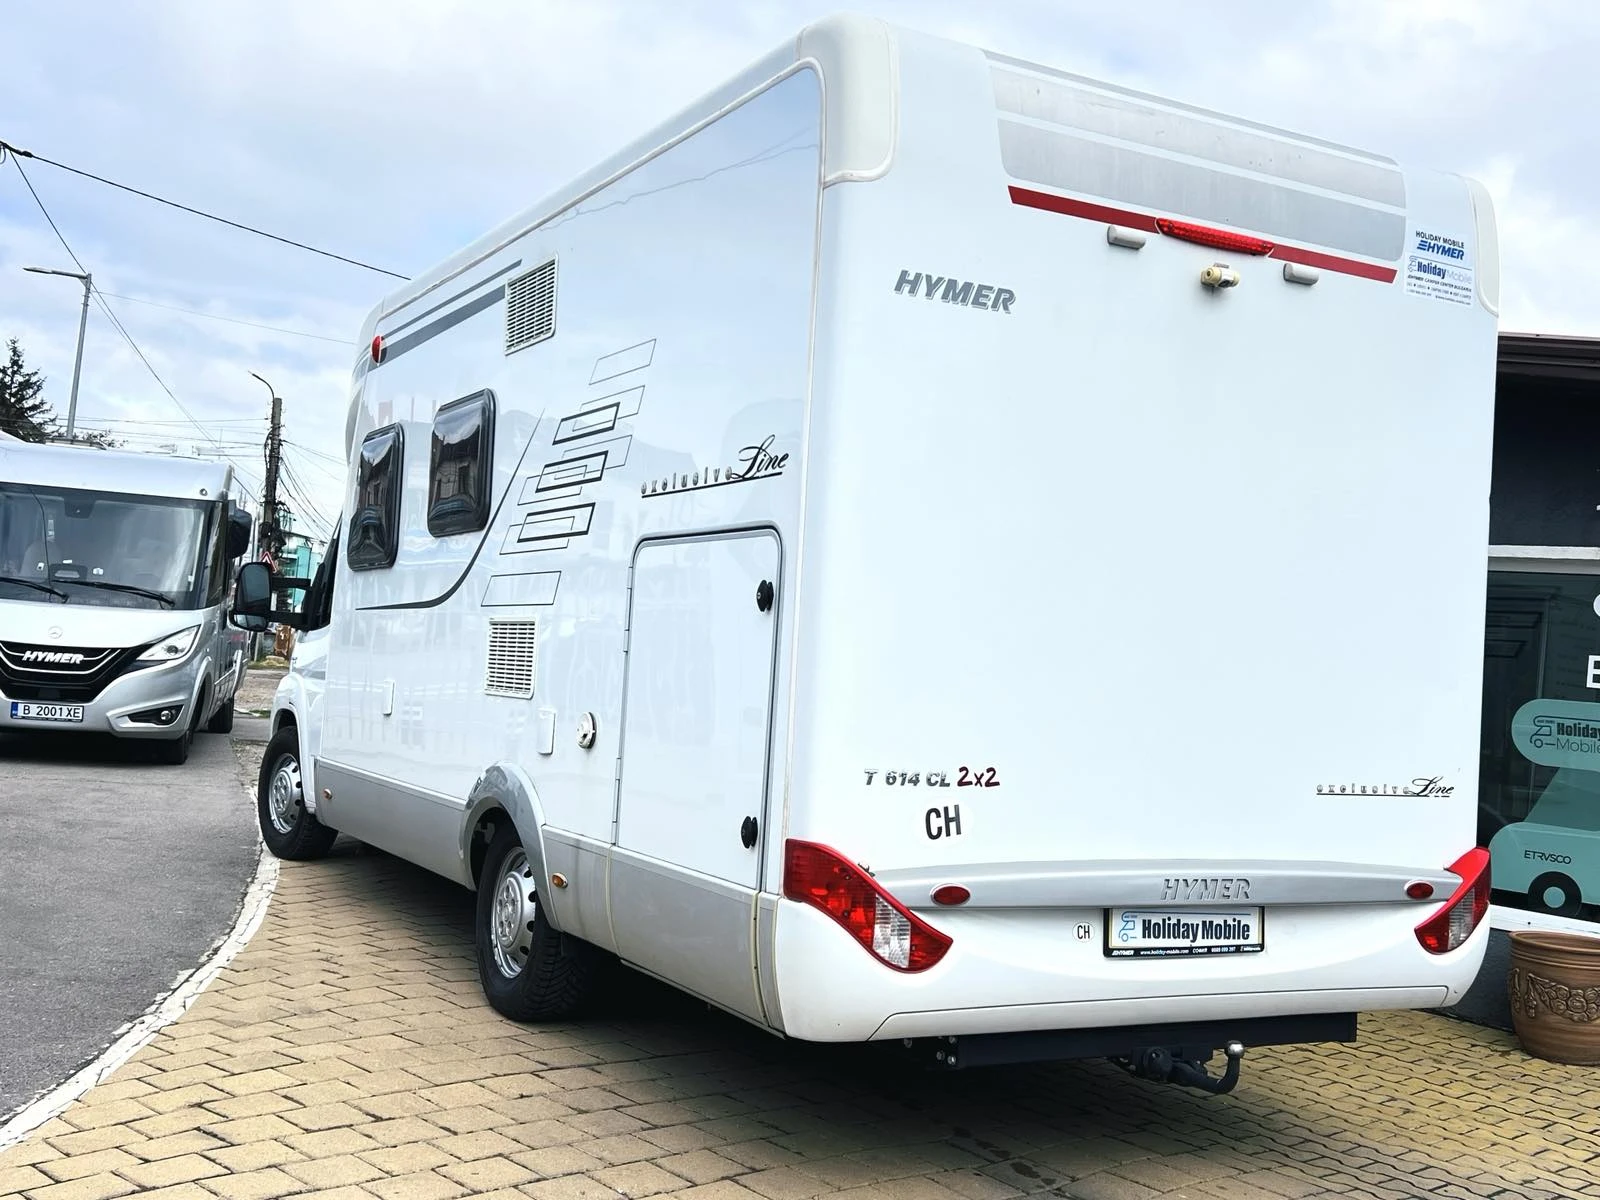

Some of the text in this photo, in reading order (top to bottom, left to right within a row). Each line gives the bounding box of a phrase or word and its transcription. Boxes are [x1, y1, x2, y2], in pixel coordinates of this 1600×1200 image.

[1416, 230, 1464, 249] HOLIDAY MOBILE
[1424, 241, 1464, 260] HYMER
[1417, 260, 1447, 280] Holiday
[894, 269, 1016, 314] HYMER
[731, 434, 789, 479] Line
[22, 650, 83, 664] HYMER
[23, 705, 81, 718] B 2001 XE
[864, 766, 1000, 787] T 614 CL 2x2
[1409, 776, 1454, 796] Line
[925, 804, 961, 840] CH
[1161, 878, 1250, 900] HYMER
[1077, 925, 1090, 939] CH
[1142, 917, 1250, 943] Holiday Mobile
